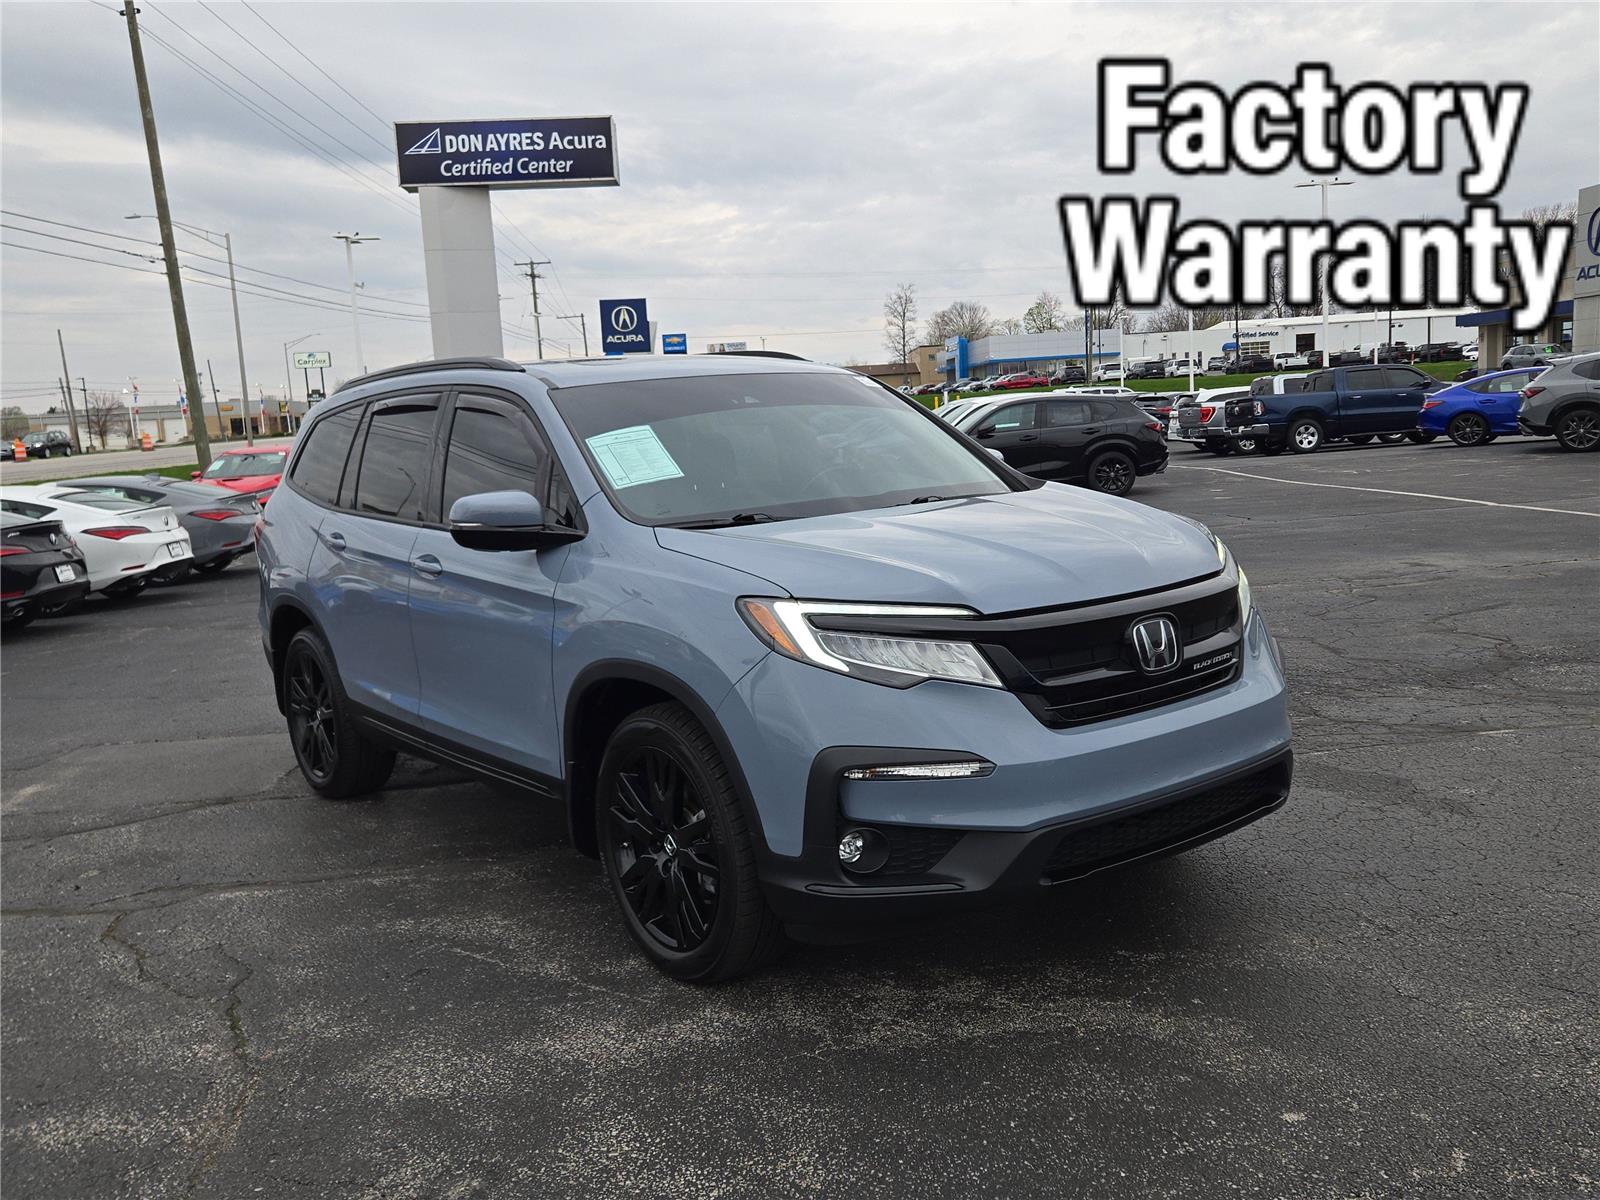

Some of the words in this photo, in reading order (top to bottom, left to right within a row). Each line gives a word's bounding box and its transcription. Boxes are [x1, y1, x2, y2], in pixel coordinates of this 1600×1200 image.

[445, 133, 483, 153] DON
[486, 132, 545, 151] AYRES
[549, 131, 607, 150] Acura
[440, 157, 513, 177] Certified
[516, 157, 573, 174] Center
[606, 334, 645, 344] ACURA
